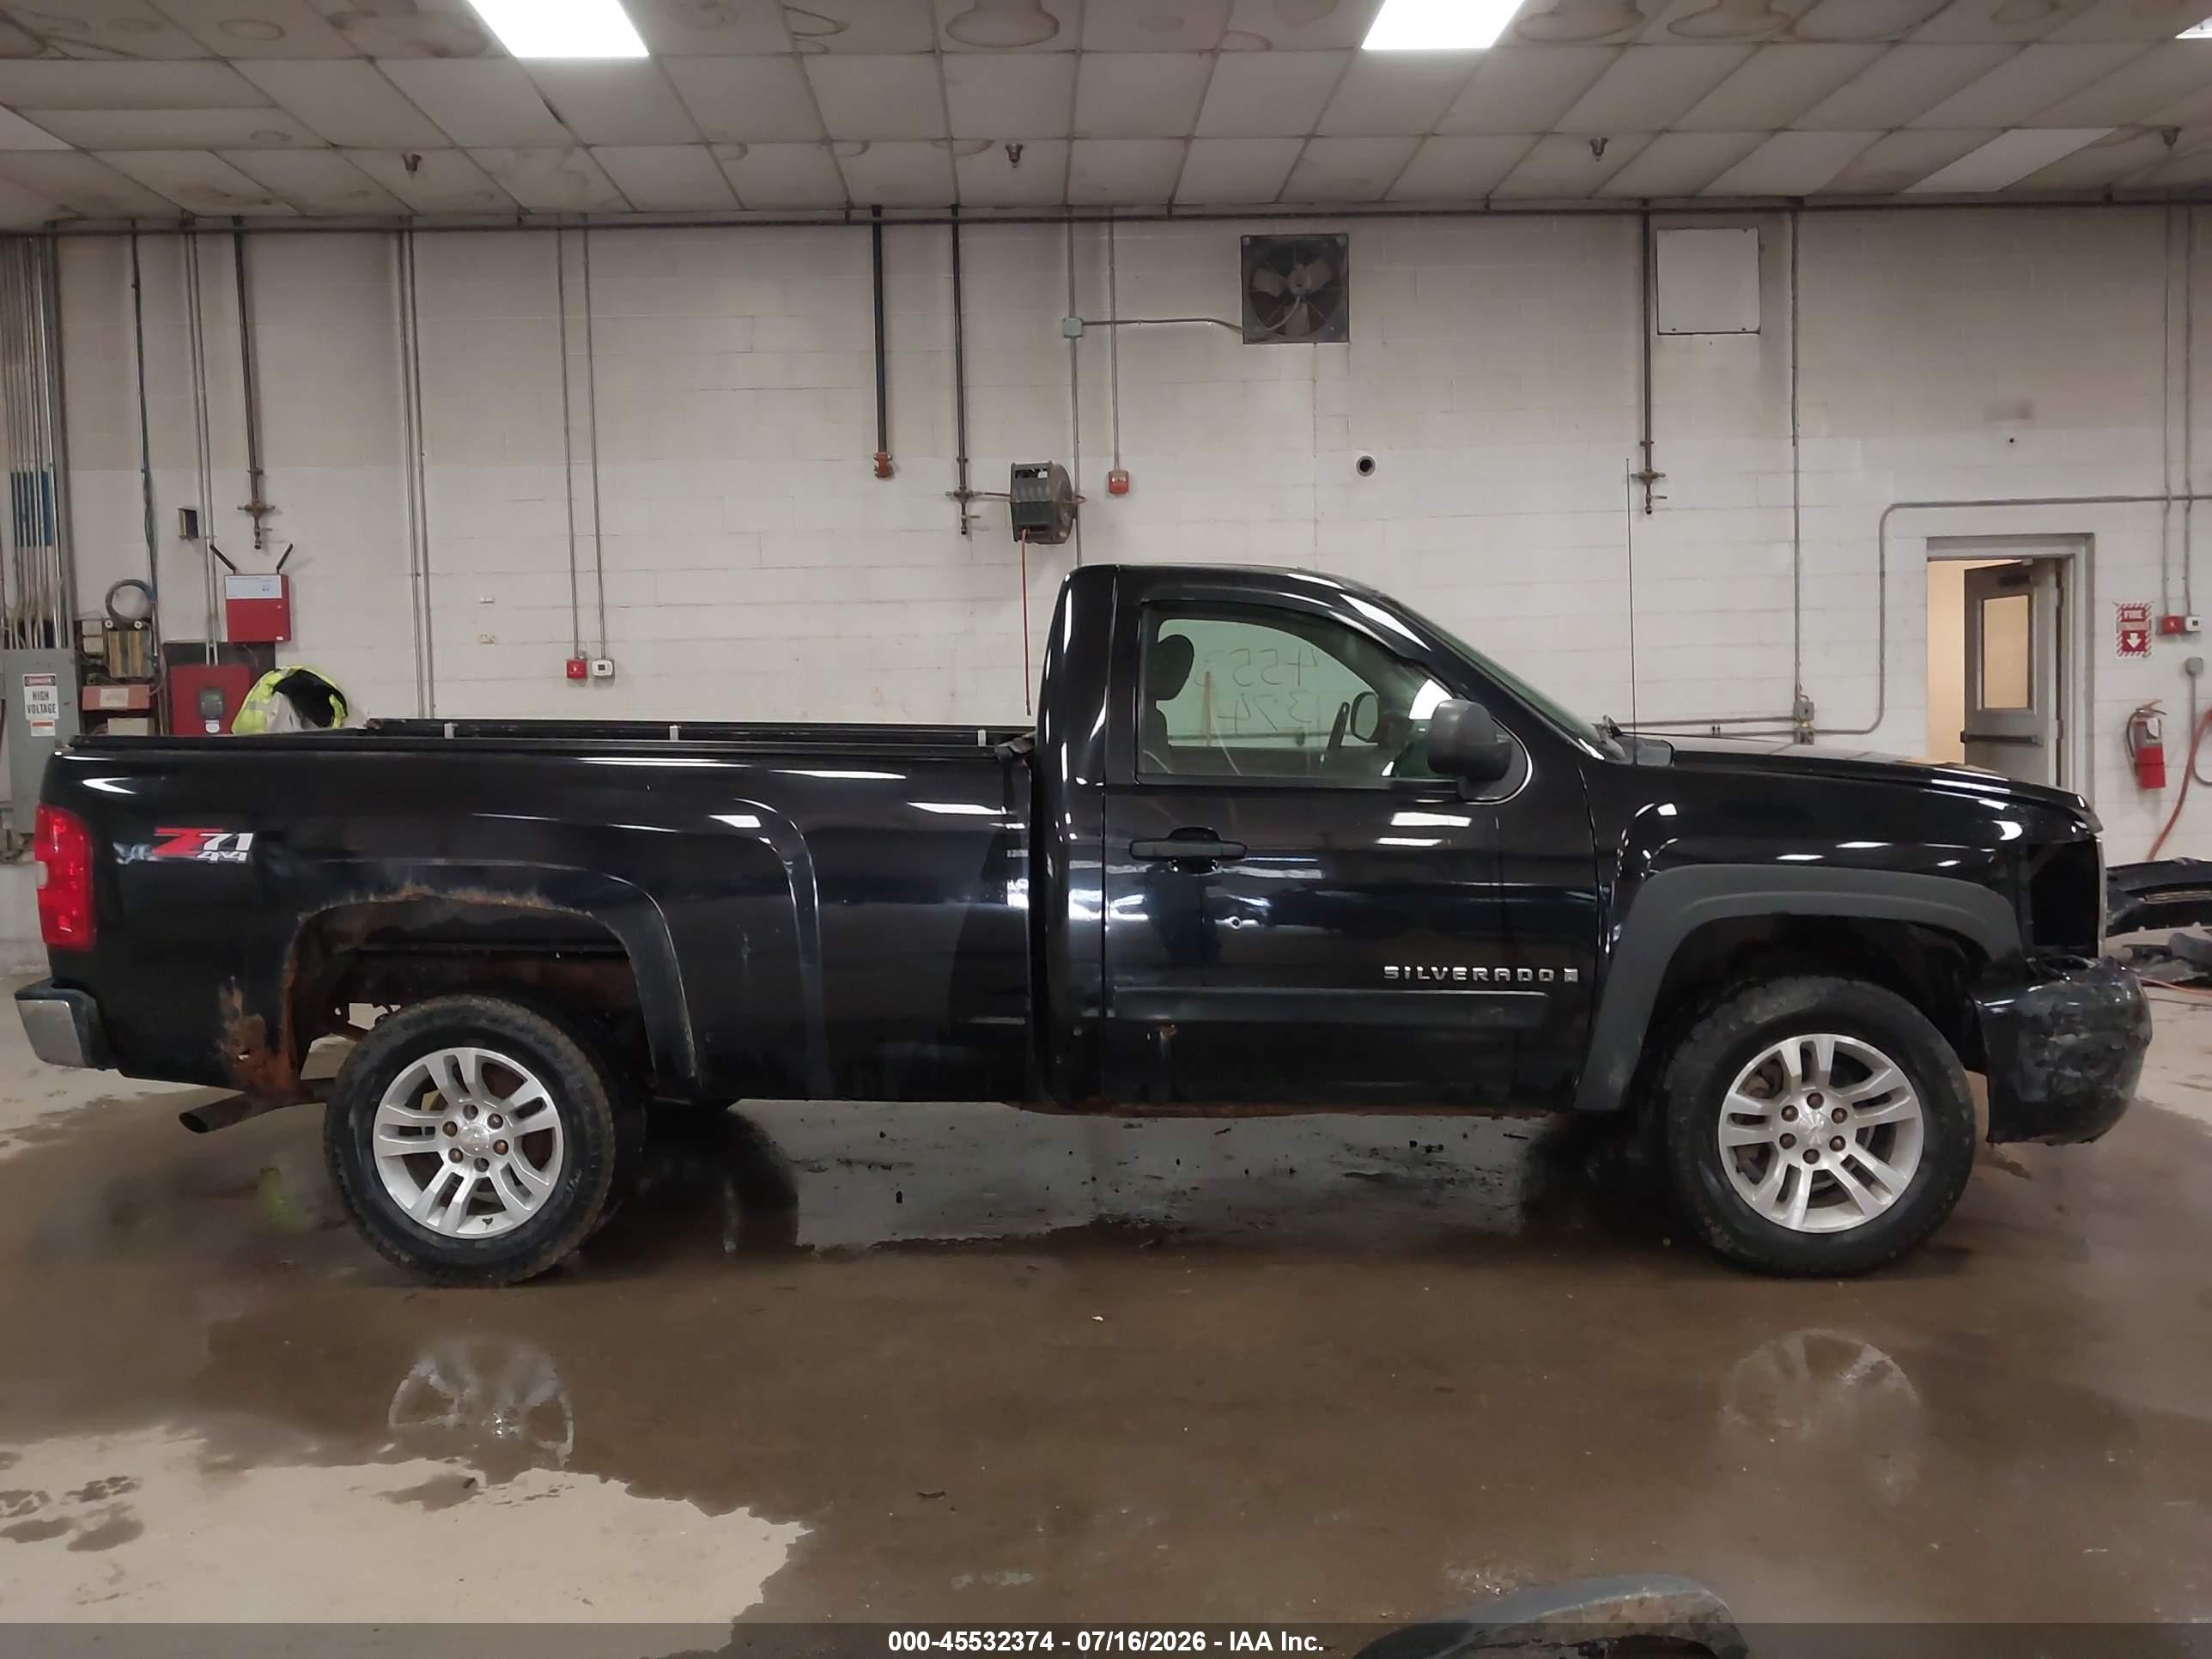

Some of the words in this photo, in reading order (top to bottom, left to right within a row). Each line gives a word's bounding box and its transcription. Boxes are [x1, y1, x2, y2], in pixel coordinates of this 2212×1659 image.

[32, 690, 50, 702] HIGH
[27, 703, 57, 714] VOLTAGE
[151, 827, 255, 860] Z71
[1383, 965, 1555, 982] SILVERADO
